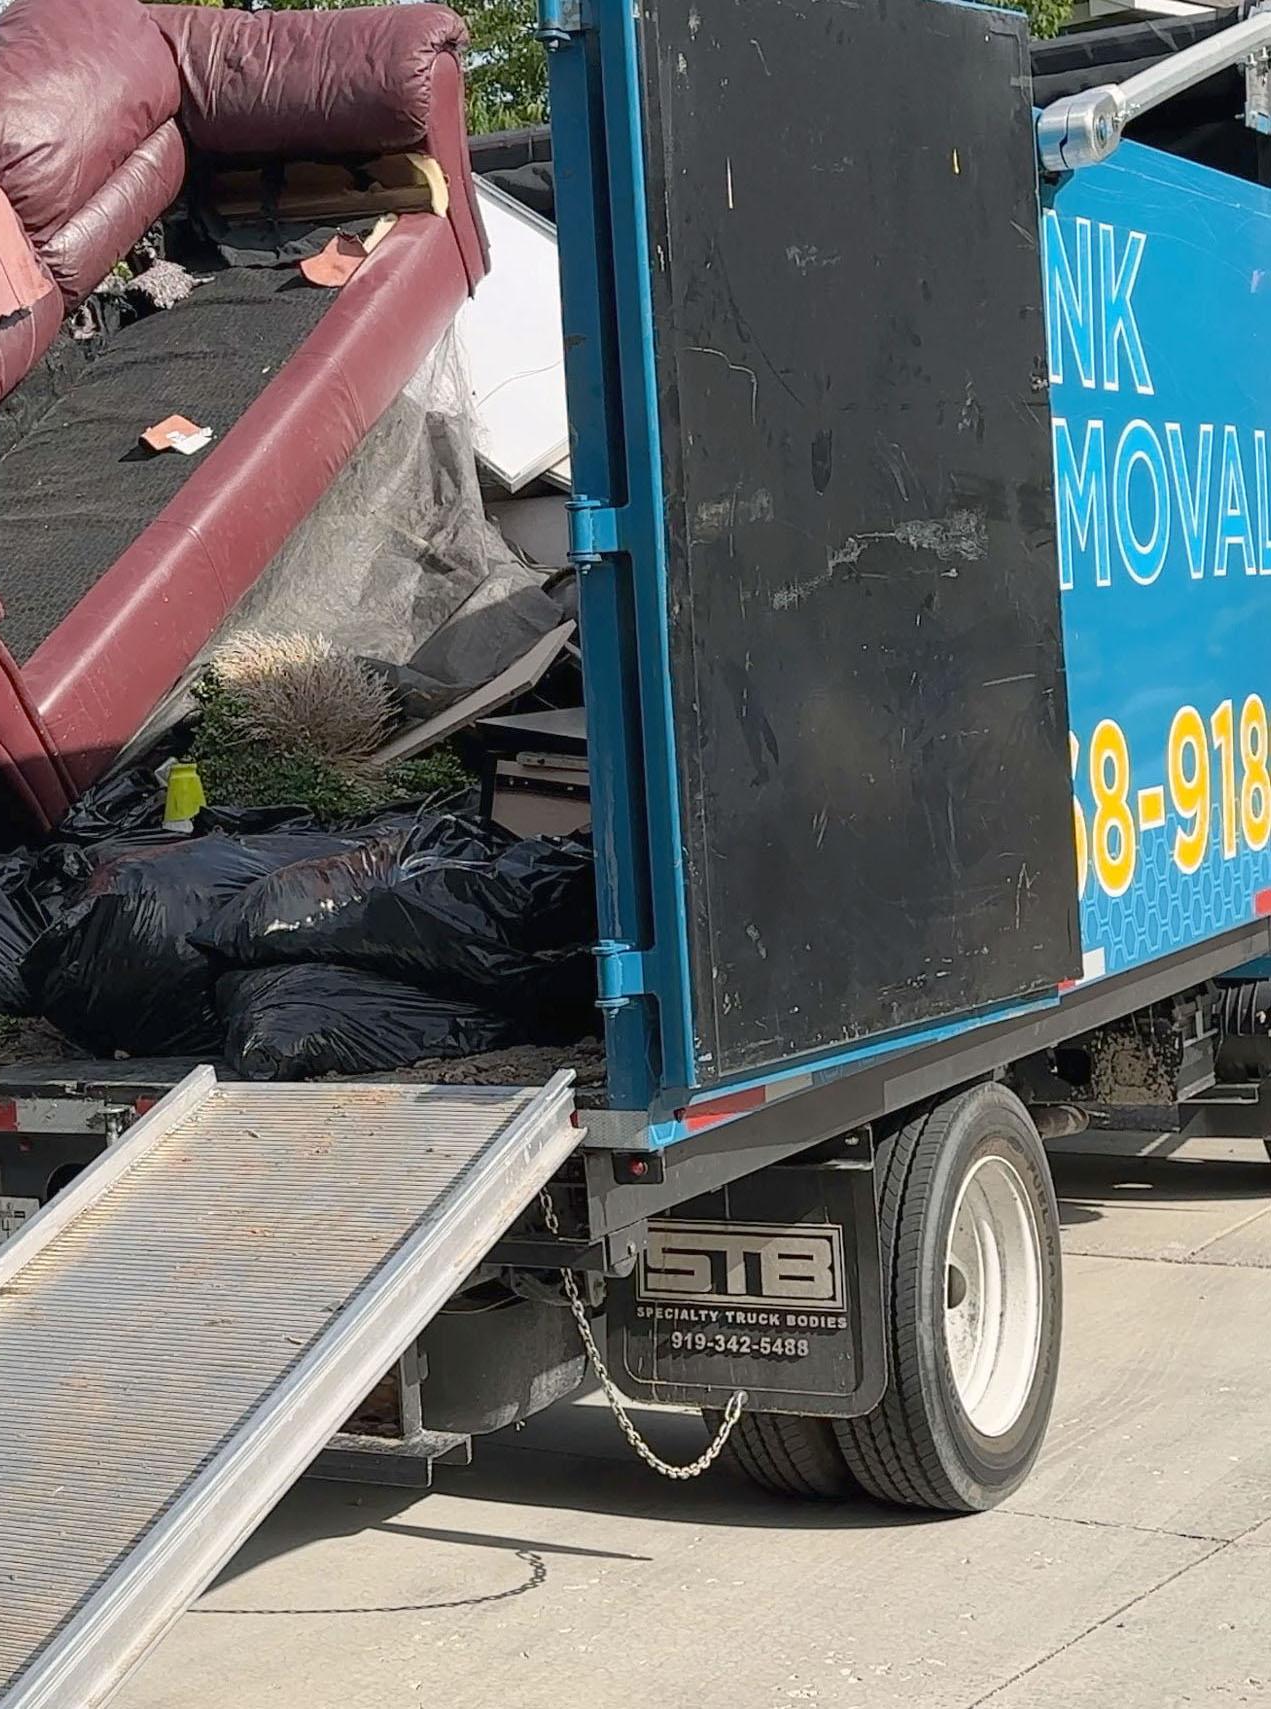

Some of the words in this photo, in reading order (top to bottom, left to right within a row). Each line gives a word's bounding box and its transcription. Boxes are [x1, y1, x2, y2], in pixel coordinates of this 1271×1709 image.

[646, 1229, 834, 1299] STB
[636, 1306, 720, 1323] SPECIALTY
[725, 1311, 780, 1327] TRUCK
[786, 1315, 848, 1330] BODIES
[671, 1331, 810, 1357] 919-342-5488
